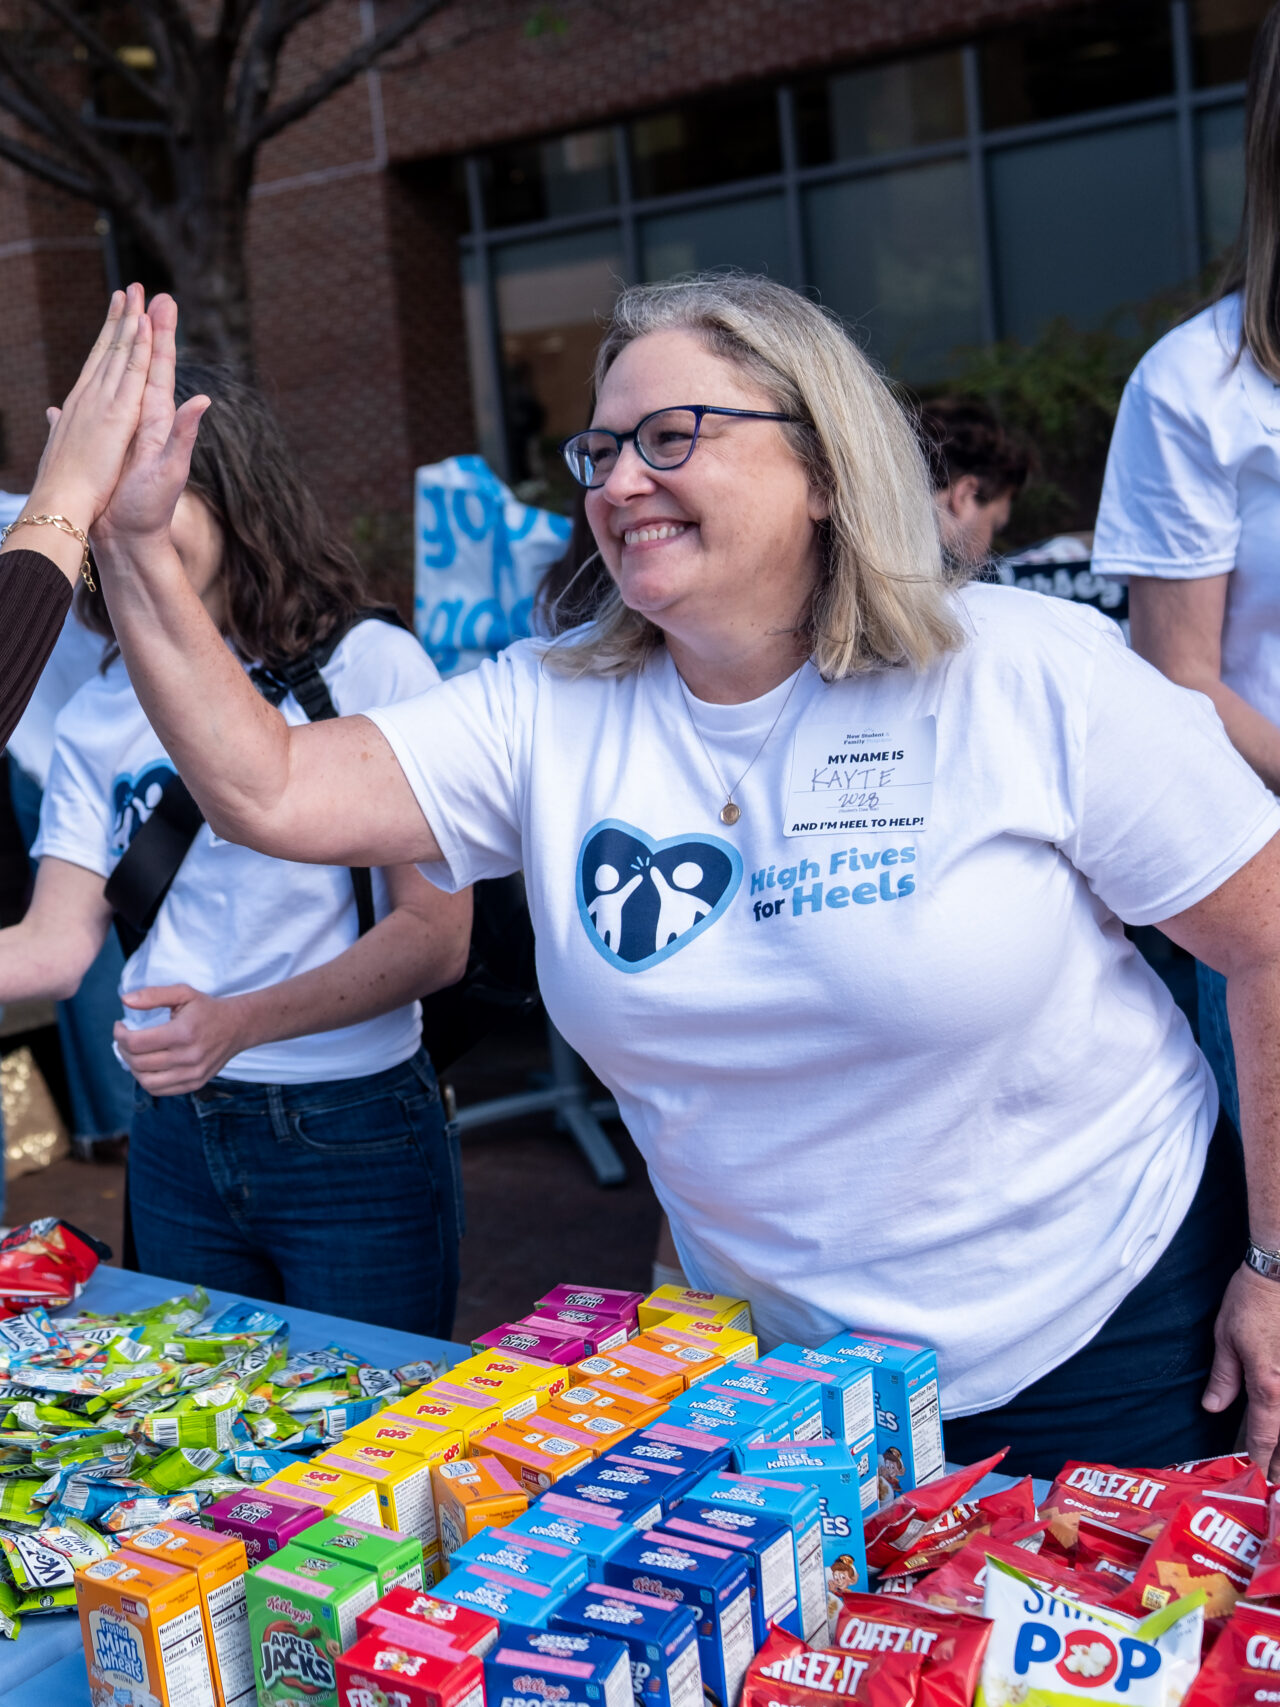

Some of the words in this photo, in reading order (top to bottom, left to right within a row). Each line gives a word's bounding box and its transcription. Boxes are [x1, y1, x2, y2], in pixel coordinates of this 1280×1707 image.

[827, 754, 848, 765] MY
[849, 751, 890, 764] NAME
[891, 750, 905, 761] IS
[811, 767, 896, 792] KAYTE
[792, 822, 818, 832] AND
[819, 821, 837, 831] I'M
[839, 820, 869, 830] HEEL
[871, 818, 887, 828] TO
[889, 816, 925, 828] HELP!
[750, 858, 821, 896] High
[829, 846, 917, 876] Fives
[753, 898, 786, 922] for
[792, 870, 917, 917] Heels
[498, 1339, 532, 1350] Bran
[854, 1345, 882, 1357] RICE
[837, 1348, 885, 1364] KRISPIES
[485, 1362, 522, 1373] POPS
[549, 1378, 566, 1397] POPS
[721, 1379, 769, 1396] KRISPIES
[738, 1375, 767, 1388] RICE
[417, 1404, 453, 1416] POPS
[689, 1402, 738, 1418] KRISPIES
[706, 1398, 735, 1411] RICE
[376, 1428, 414, 1440] POPS
[359, 1447, 396, 1458] POPS
[443, 1443, 461, 1462] POPS
[778, 1453, 809, 1462] RICE
[767, 1458, 824, 1470] KRISPIES
[305, 1471, 342, 1483] POPS
[227, 1509, 261, 1524] Bran
[233, 1502, 273, 1519] Raisin
[548, 1521, 579, 1536] RICE
[496, 1549, 527, 1564] RICE
[407, 1568, 422, 1581] Facts
[208, 1584, 232, 1602] Nutrition
[232, 1577, 245, 1589] Fact
[474, 1586, 507, 1602] RICE
[213, 1612, 237, 1630] Calories
[238, 1604, 248, 1615] 13
[267, 1595, 314, 1625] Kellogg's
[100, 1618, 130, 1637] Frosted
[159, 1617, 184, 1636] Nutrition
[184, 1609, 200, 1623] Facts
[96, 1629, 139, 1662] Mini
[163, 1646, 188, 1663] Calories
[190, 1634, 204, 1649] 130
[270, 1632, 316, 1657] APPLE
[1014, 1621, 1162, 1692] POP
[96, 1648, 145, 1684] Wheats
[261, 1643, 335, 1689] JACKS
